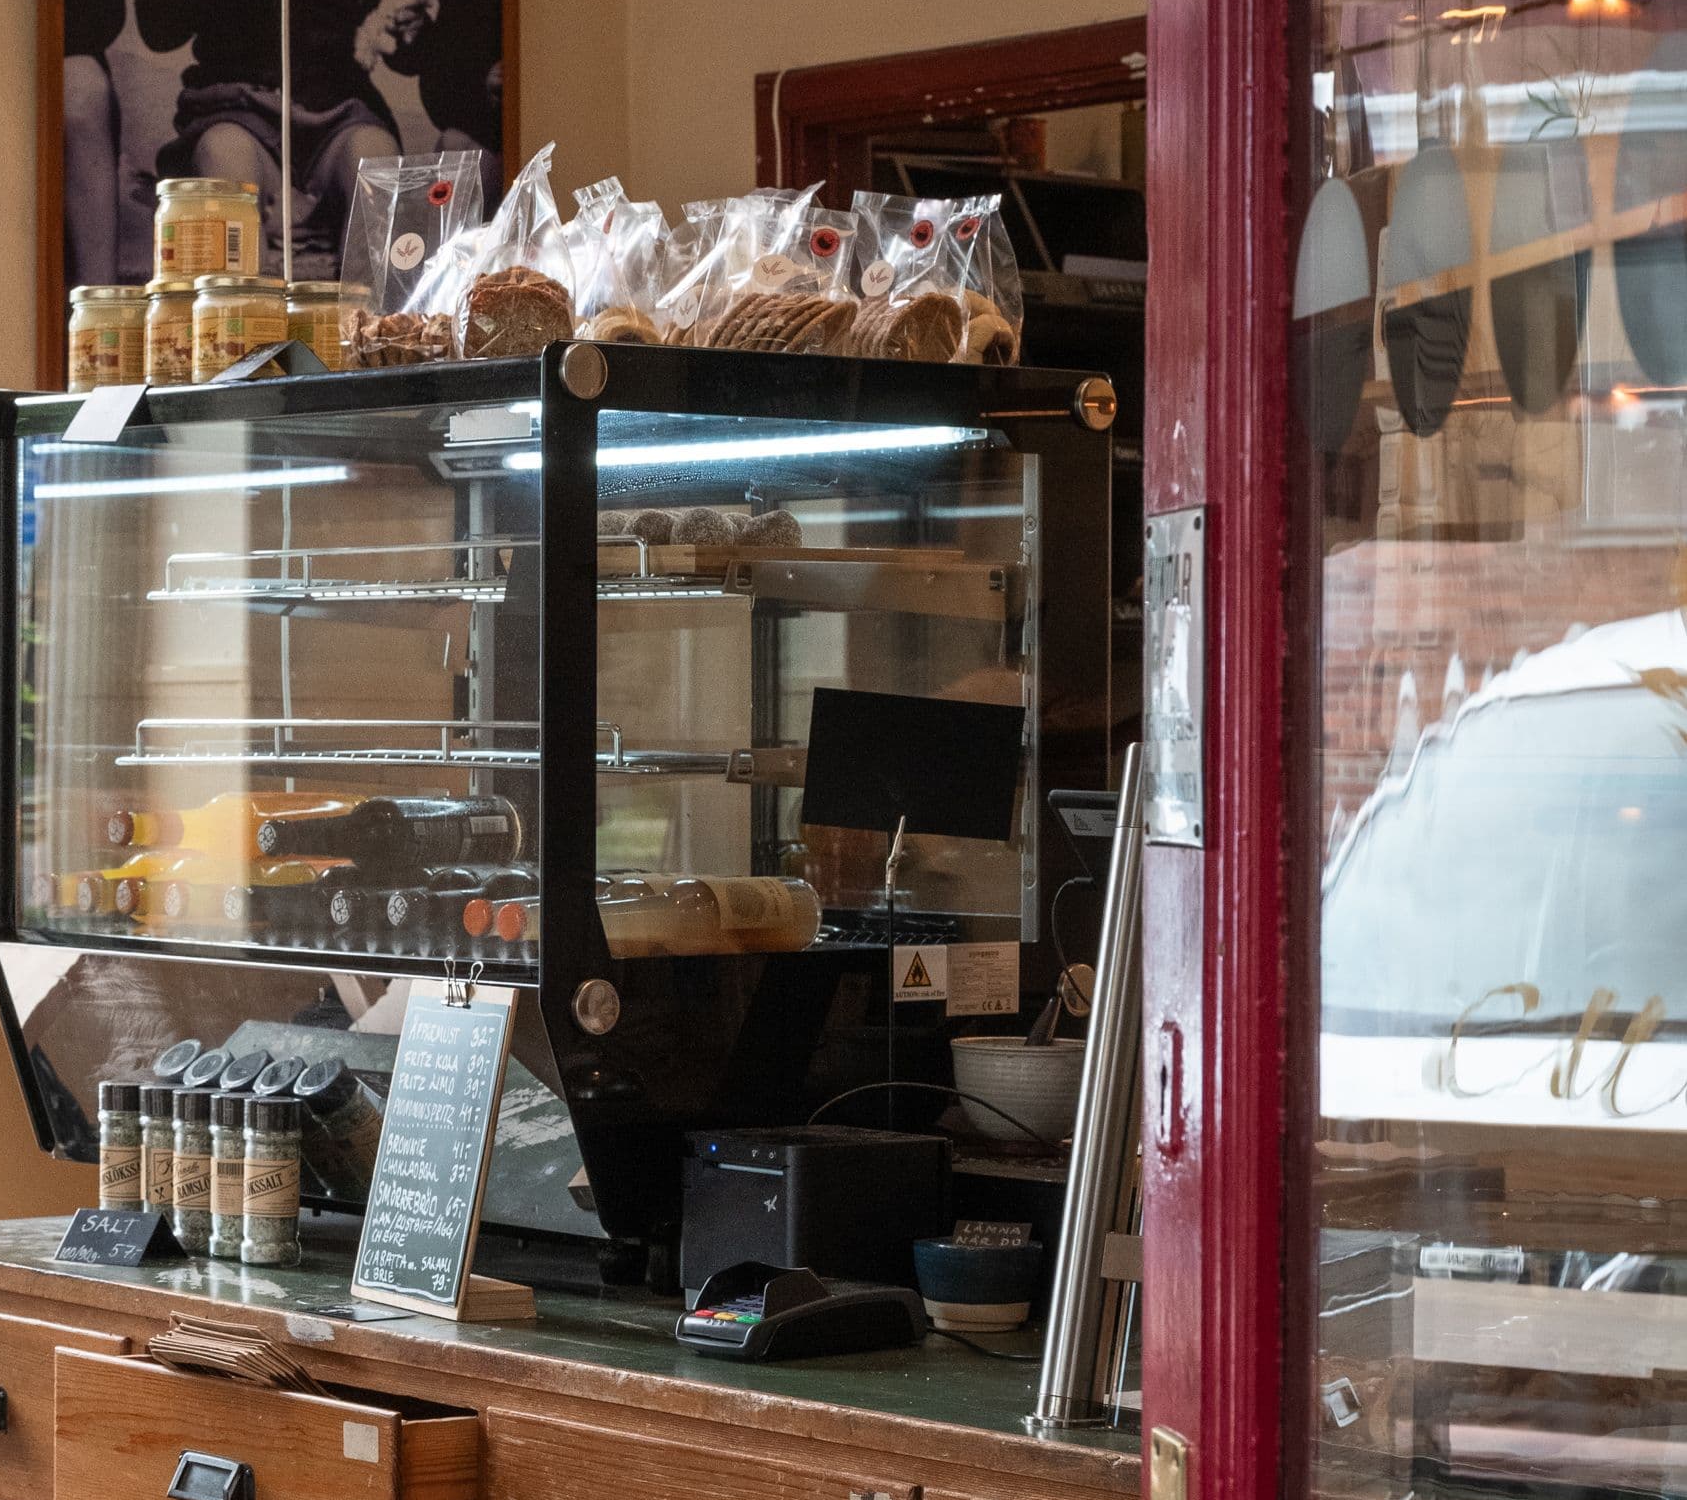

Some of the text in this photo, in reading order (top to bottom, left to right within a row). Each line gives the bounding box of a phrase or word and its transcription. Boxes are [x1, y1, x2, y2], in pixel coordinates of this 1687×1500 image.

[404, 1050, 432, 1068] FRITZ
[398, 1072, 426, 1091] FRITZ
[386, 1132, 427, 1157] BROWNIE
[81, 1214, 140, 1235] SALT
[363, 1249, 407, 1269] CIABATTA
[373, 1268, 394, 1283] BRIE
